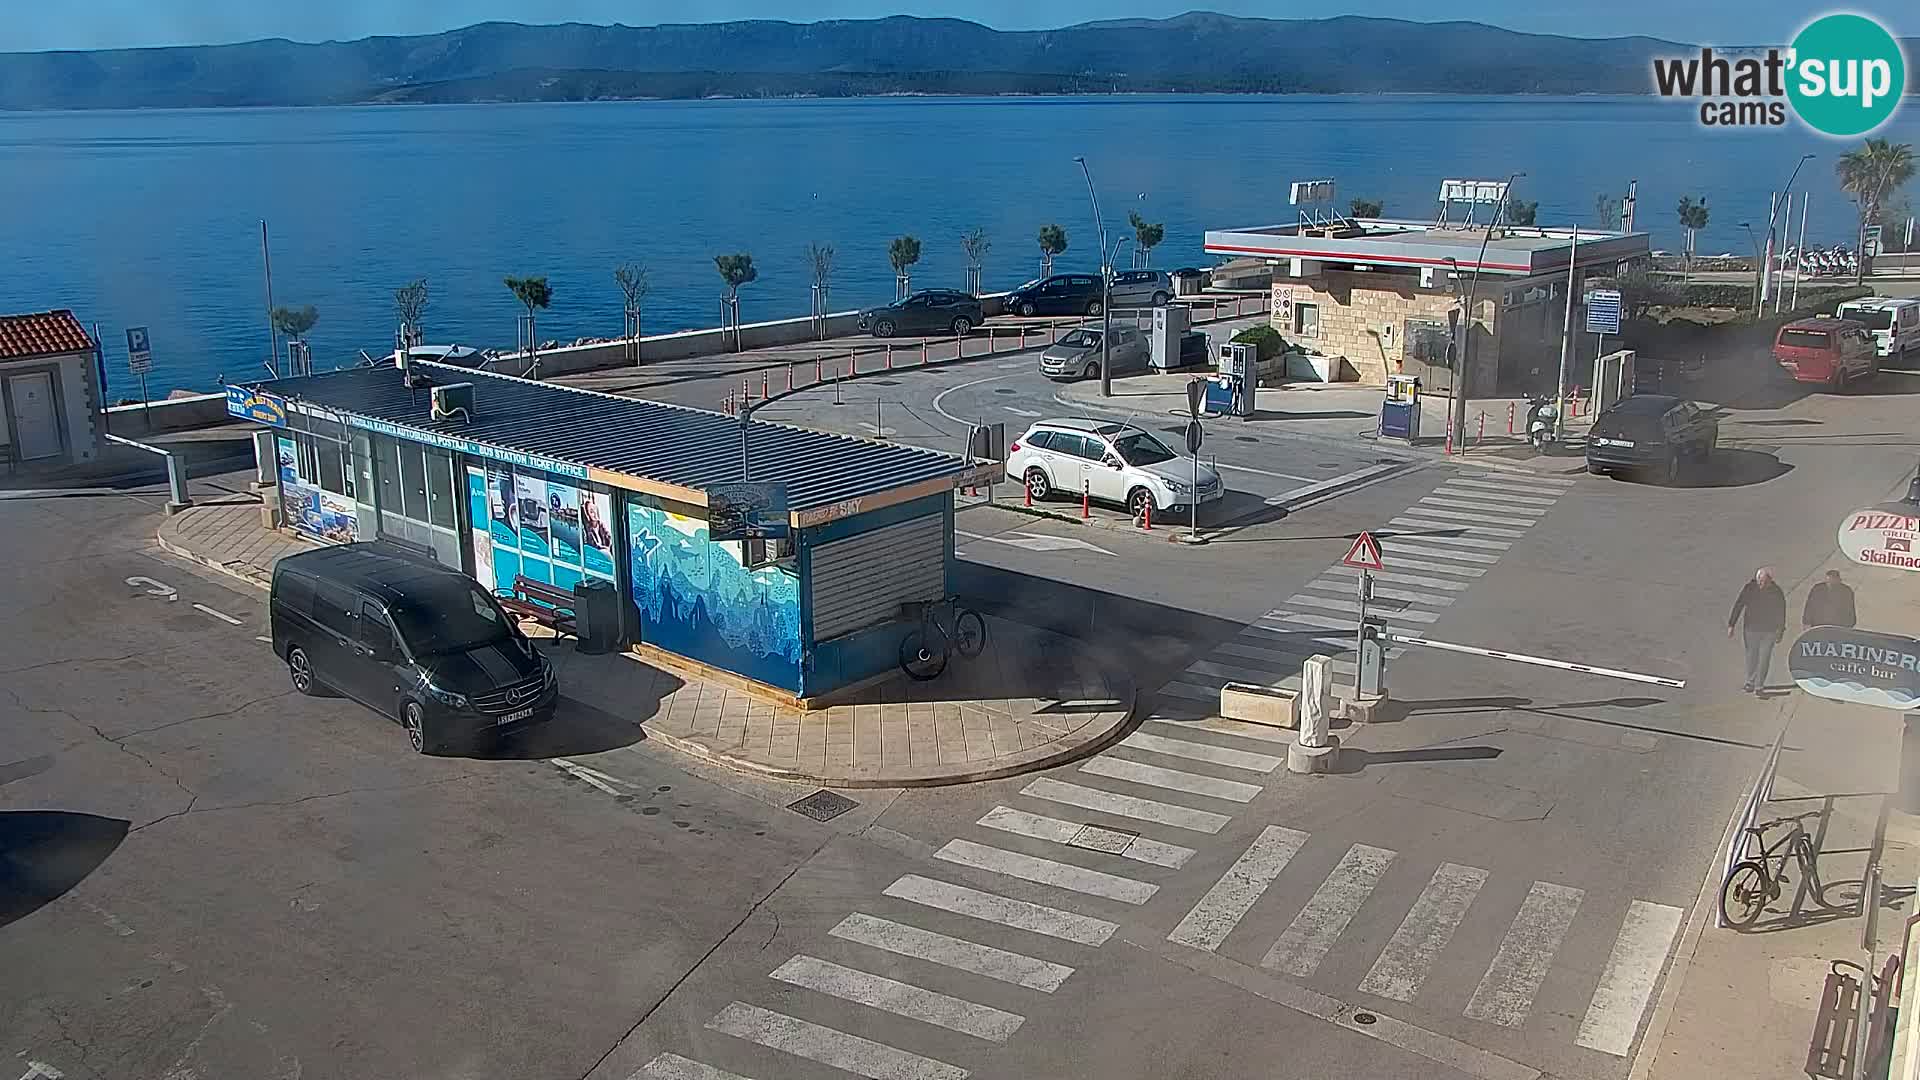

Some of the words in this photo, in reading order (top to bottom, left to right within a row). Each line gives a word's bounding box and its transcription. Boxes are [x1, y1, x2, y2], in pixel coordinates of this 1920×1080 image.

[132, 330, 144, 349] P
[437, 436, 469, 452] POSTAJA
[479, 445, 493, 457] BUS
[494, 448, 527, 465] STATION
[529, 456, 556, 471] TICKET
[555, 462, 584, 477] OFFICE
[1848, 515, 1920, 532] PIZZE
[1882, 530, 1918, 540] GRILL
[1830, 661, 1866, 675] caffe
[1871, 665, 1897, 680] bar
